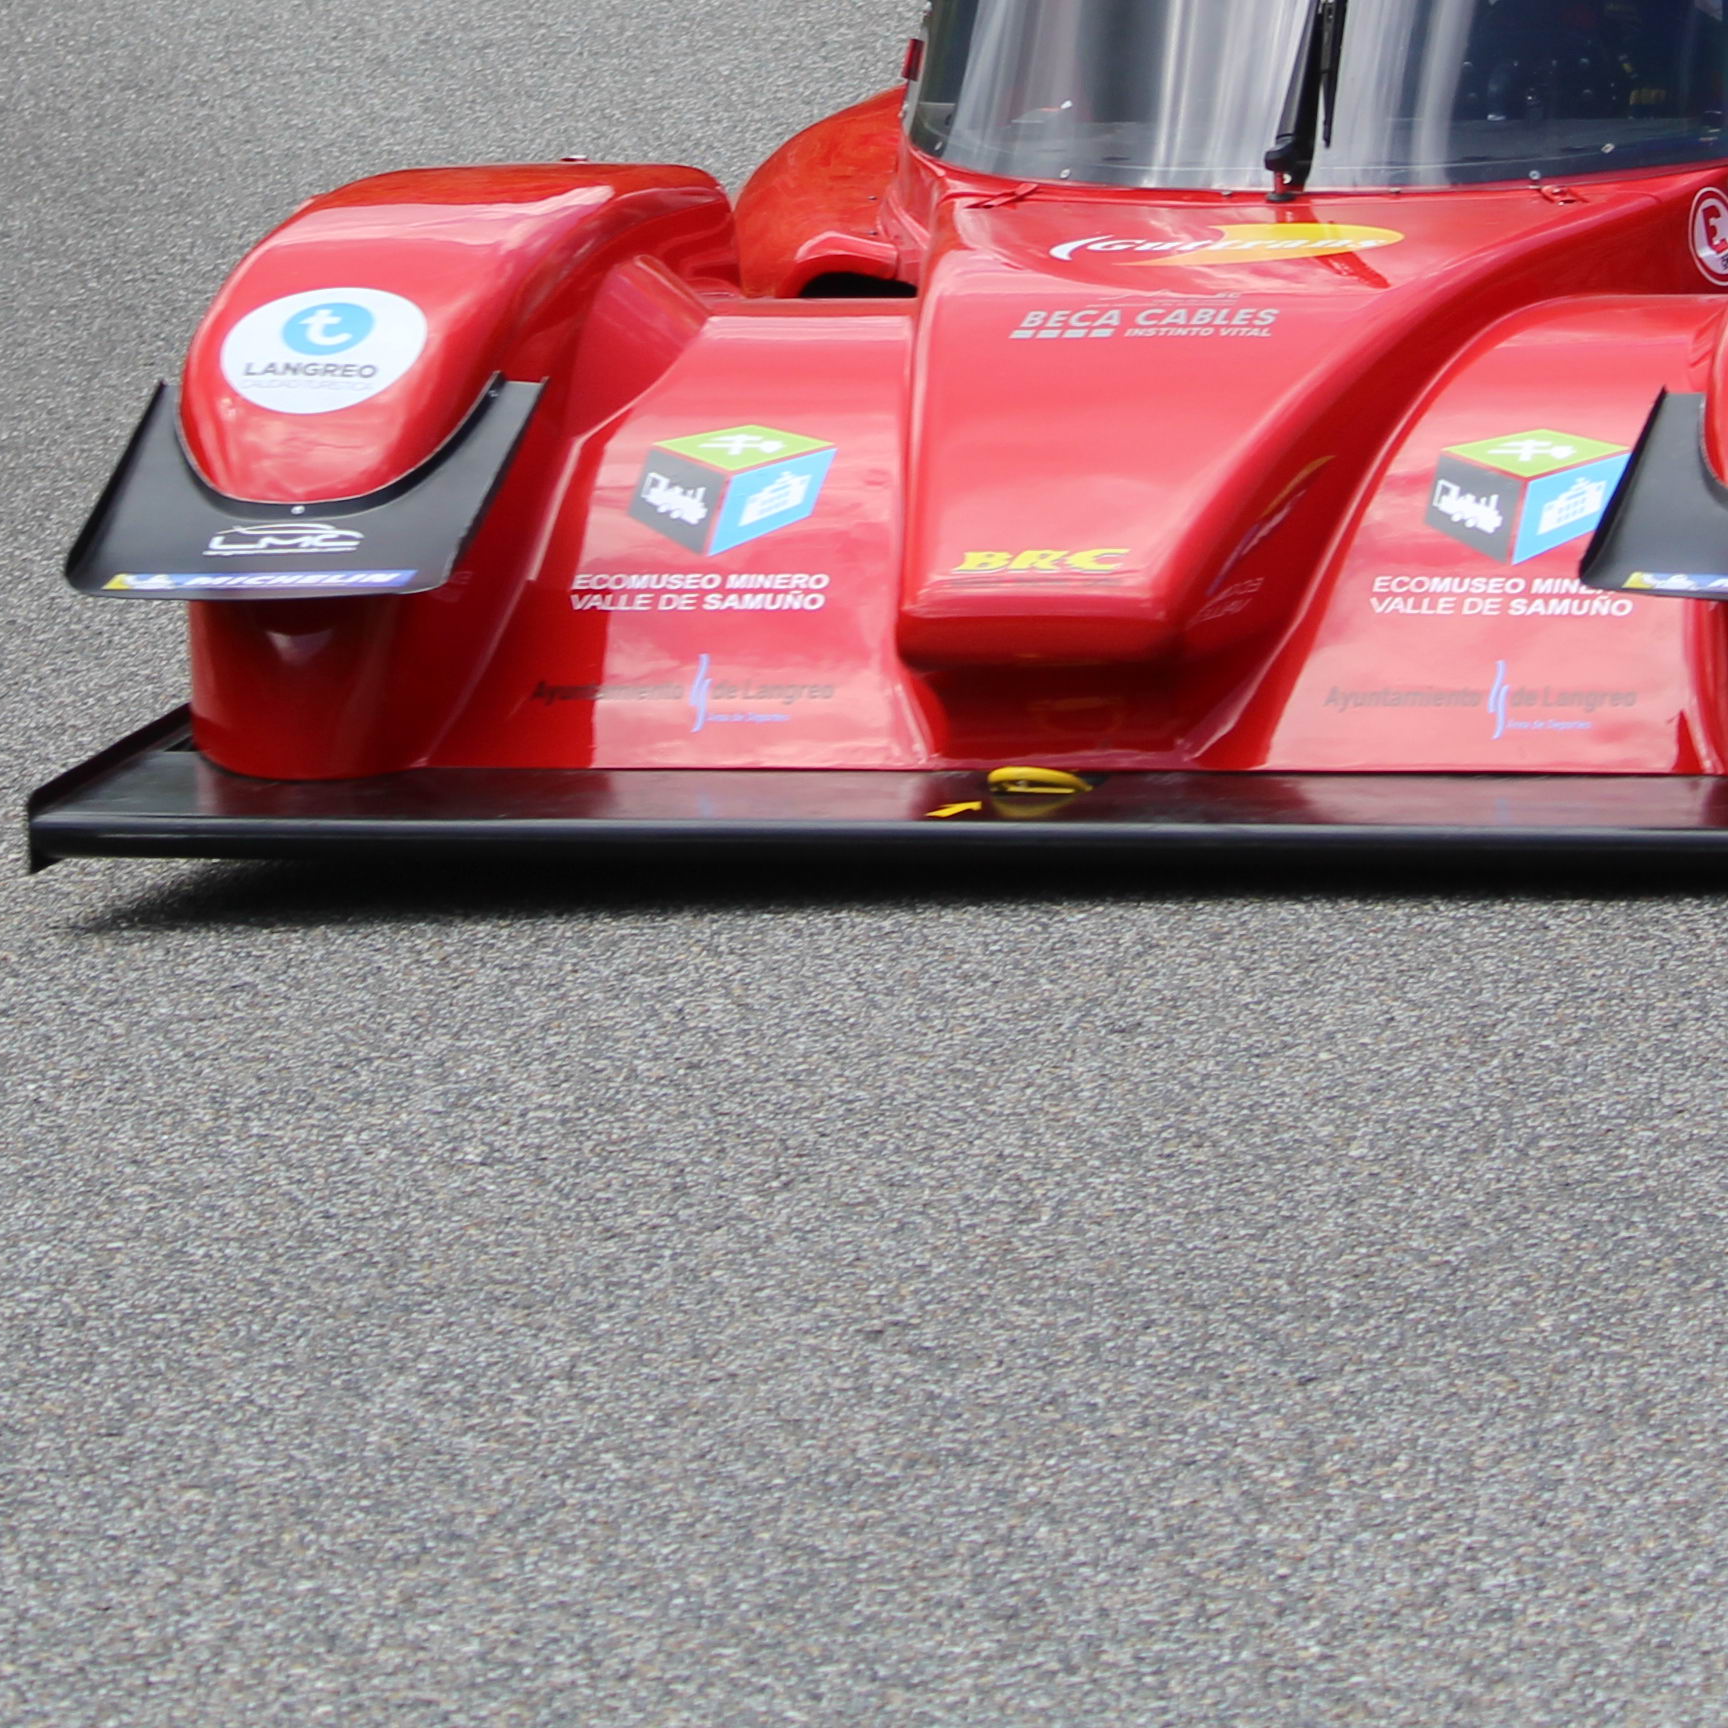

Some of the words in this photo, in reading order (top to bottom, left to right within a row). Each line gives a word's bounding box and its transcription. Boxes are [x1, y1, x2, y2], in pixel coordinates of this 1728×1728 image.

[1019, 309, 1122, 328] BECA
[1134, 307, 1280, 326] CABLES
[1124, 326, 1215, 338] INSTINTO
[1219, 325, 1273, 337] VITAL
[242, 362, 379, 379] LANGREO
[208, 532, 362, 551] LMC
[950, 547, 1132, 573] BRC
[183, 572, 401, 587] MICHELIN
[571, 573, 722, 590] ECOMUSEO
[725, 573, 831, 590] MINERO
[1372, 576, 1526, 594] ECOMUSEO
[569, 593, 655, 611] VALLE
[657, 593, 700, 611] DE
[701, 590, 827, 611] SAMUÑO
[1369, 597, 1457, 615] VALLE
[1460, 597, 1505, 615] DE
[1507, 595, 1634, 617] SAMUÑO
[711, 681, 739, 700] de
[742, 680, 836, 705] Langreo
[1323, 685, 1483, 713] Ayuntamiento
[1511, 686, 1539, 708] de
[1542, 686, 1639, 713] Langreo
